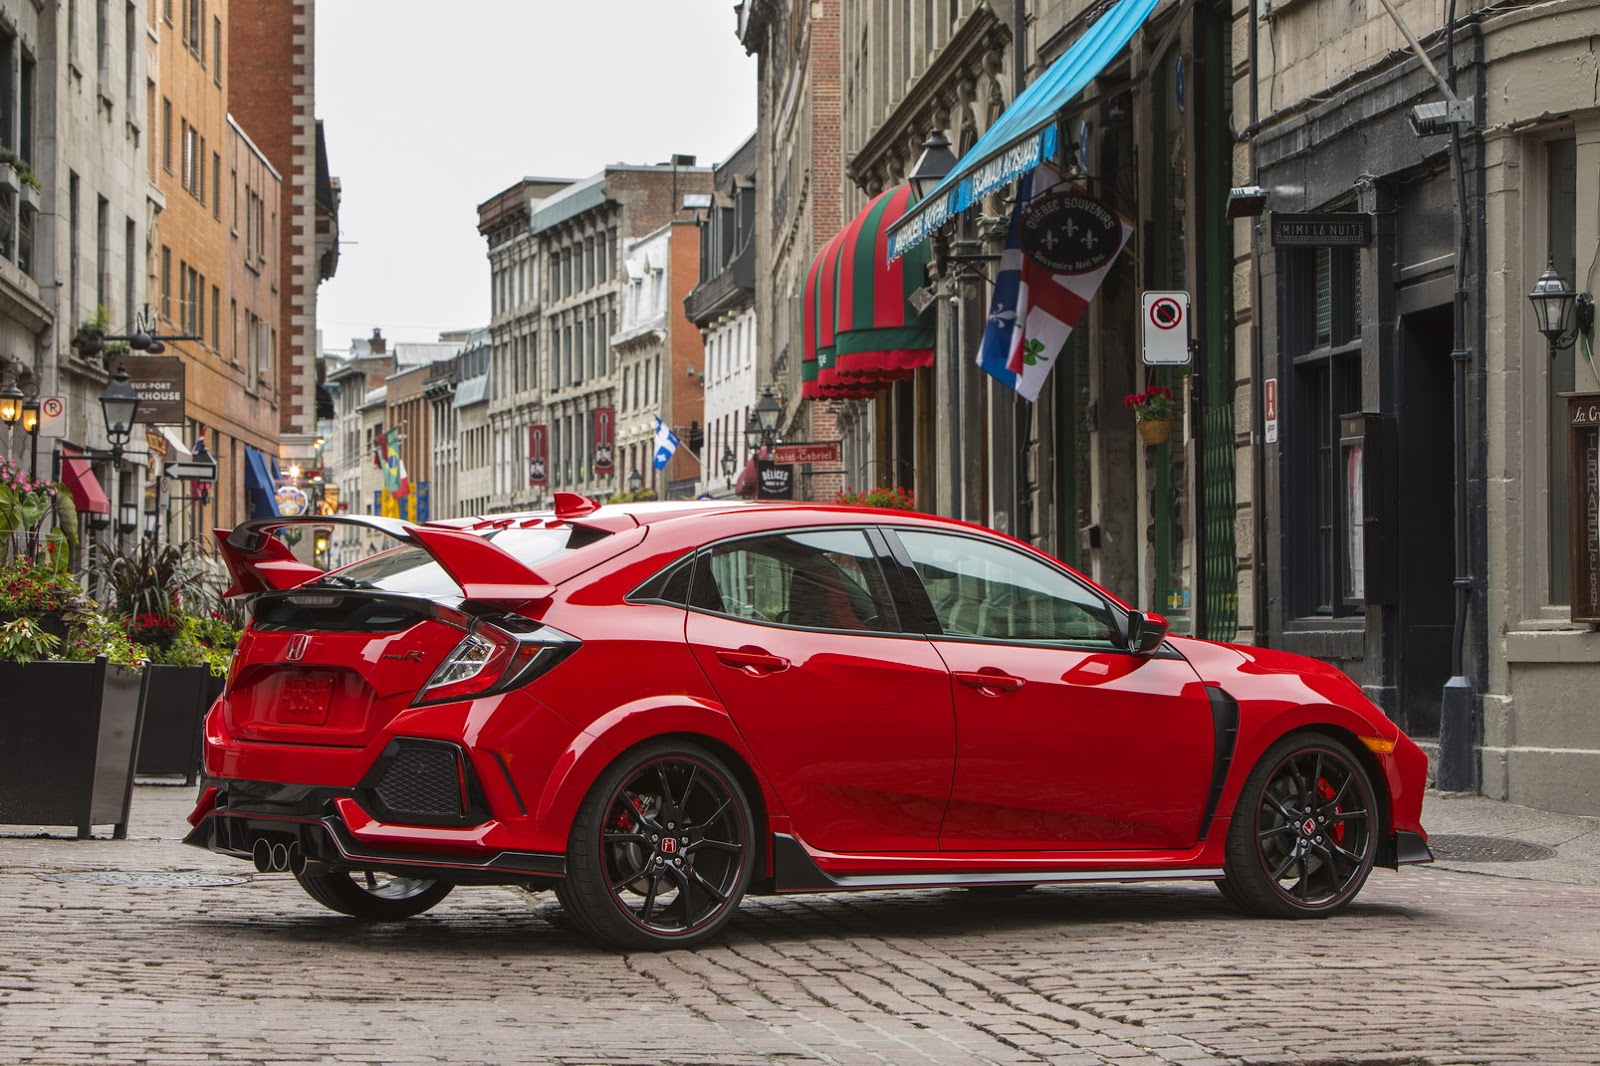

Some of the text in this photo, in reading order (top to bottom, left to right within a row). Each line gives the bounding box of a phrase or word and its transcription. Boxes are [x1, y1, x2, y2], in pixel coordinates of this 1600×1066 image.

[1063, 198, 1115, 230] SOUVENIRS
[1282, 224, 1357, 235] MIMI LA NUIT
[1033, 250, 1073, 271] Souvenirs
[137, 391, 181, 400] KHOUSE
[1573, 406, 1586, 422] La
[774, 451, 832, 462] Saint-Gabriel
[1587, 433, 1598, 552] TERRASSE
